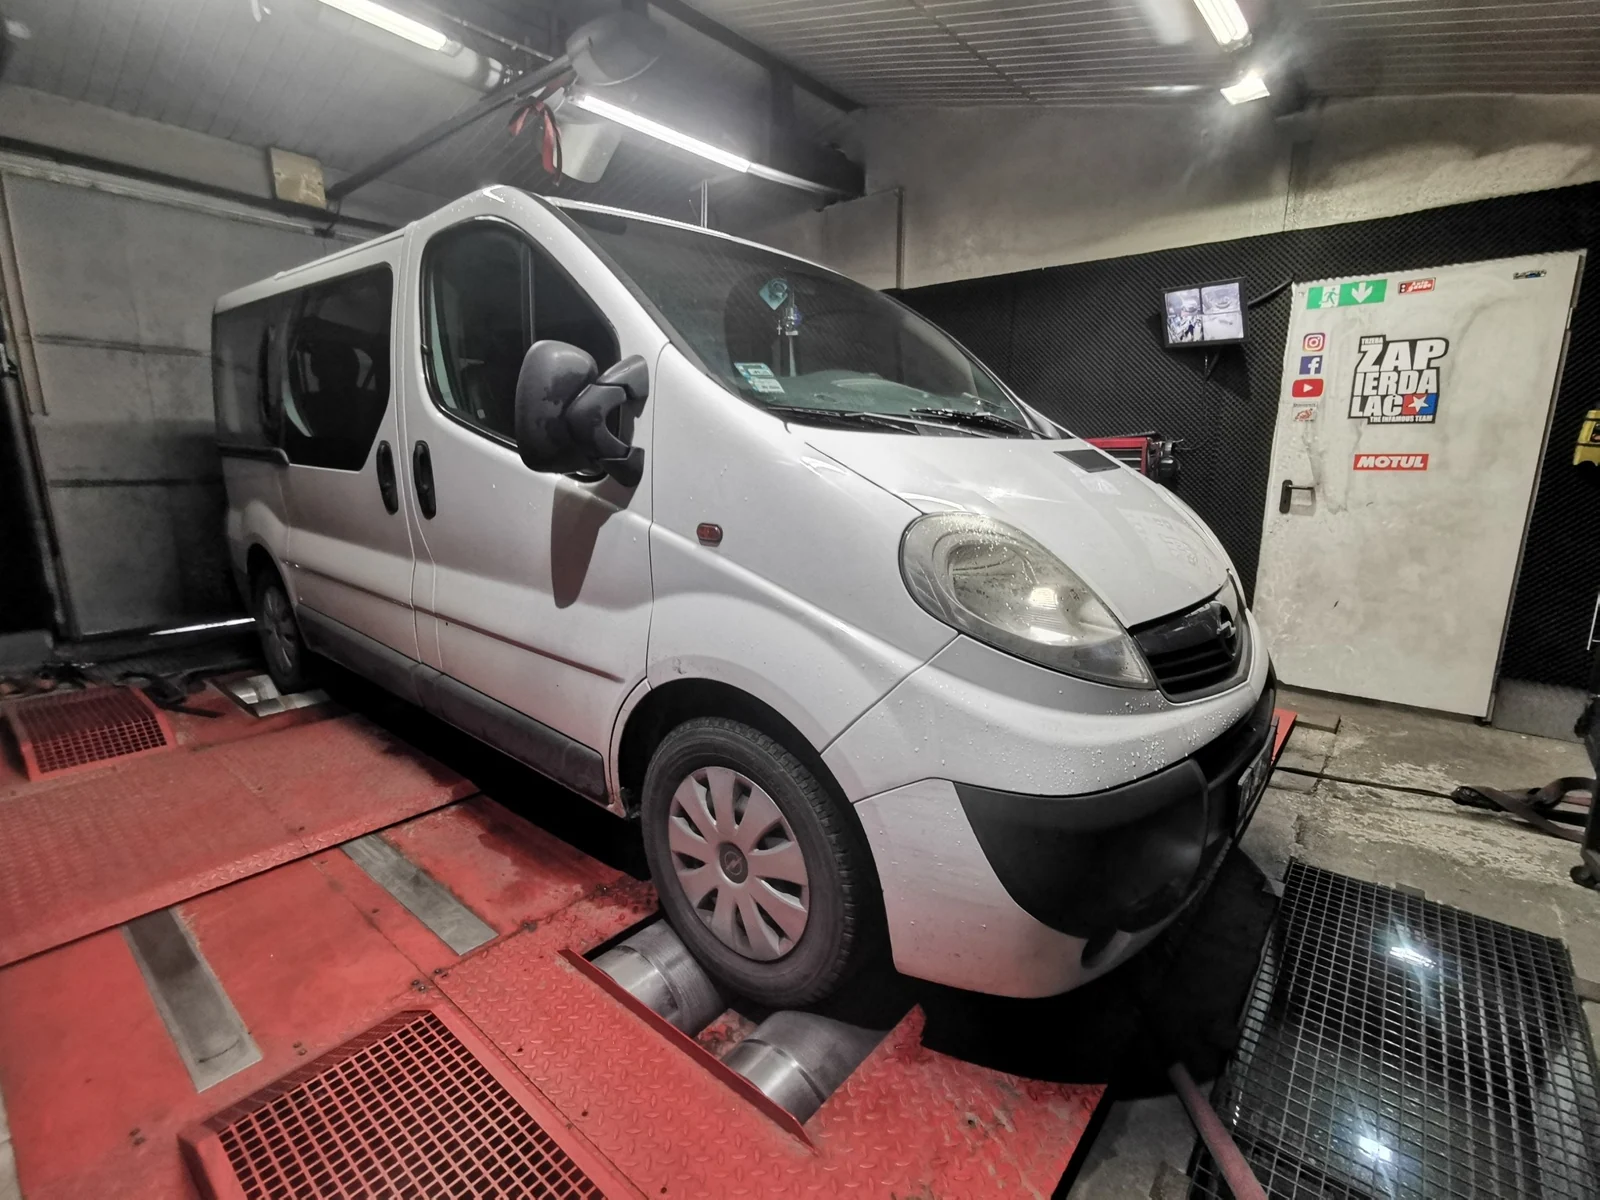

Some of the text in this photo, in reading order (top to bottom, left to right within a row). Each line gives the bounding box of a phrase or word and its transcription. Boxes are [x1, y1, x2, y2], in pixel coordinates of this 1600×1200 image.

[1357, 339, 1446, 373] ZAP
[1354, 369, 1437, 396] IERDA
[1357, 456, 1424, 468] MOTUL
